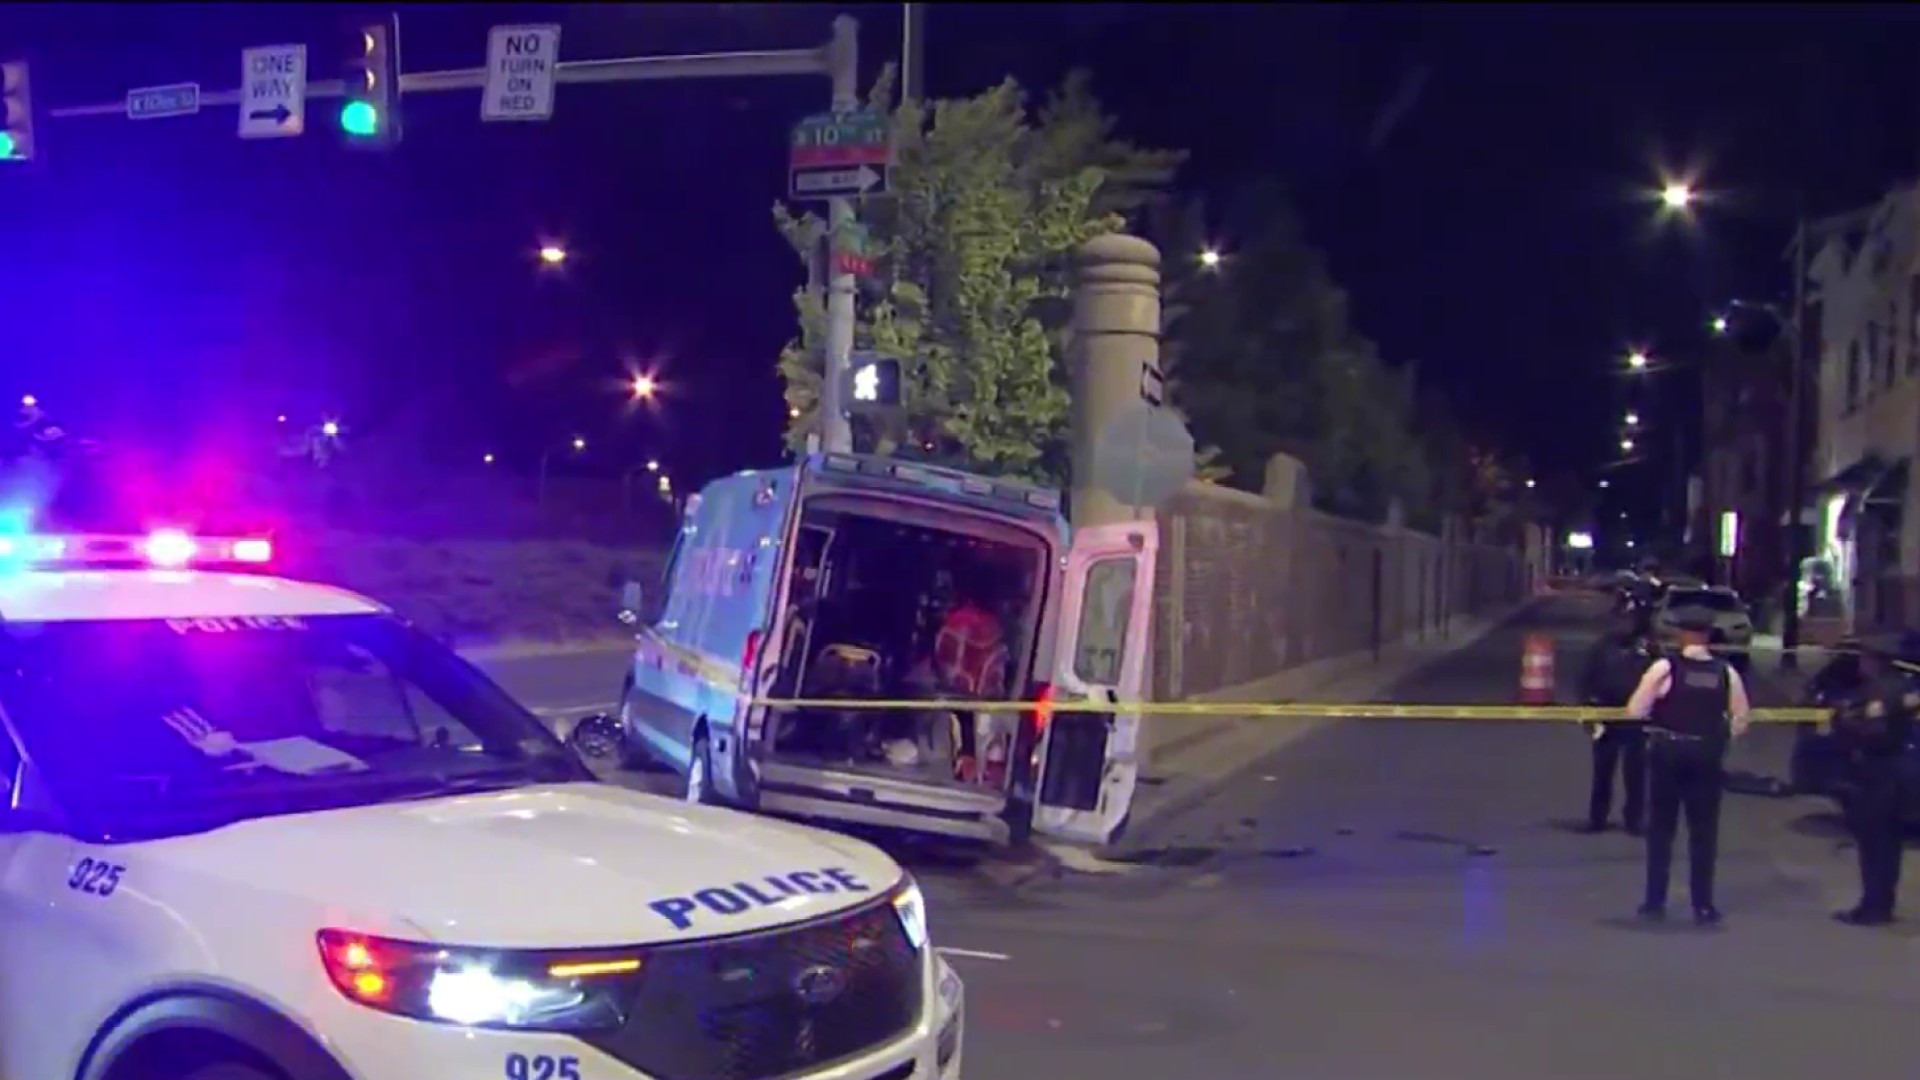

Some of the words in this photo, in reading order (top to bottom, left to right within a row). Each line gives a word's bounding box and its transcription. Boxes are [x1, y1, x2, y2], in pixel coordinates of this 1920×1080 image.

[506, 33, 540, 55] NO
[251, 54, 293, 74] ONE
[501, 59, 545, 75] TURN
[252, 78, 293, 98] WAY
[507, 77, 532, 93] ON
[501, 94, 535, 110] RED
[68, 856, 127, 896] 925
[649, 867, 869, 930] POLICE
[505, 1052, 580, 1080] 925
